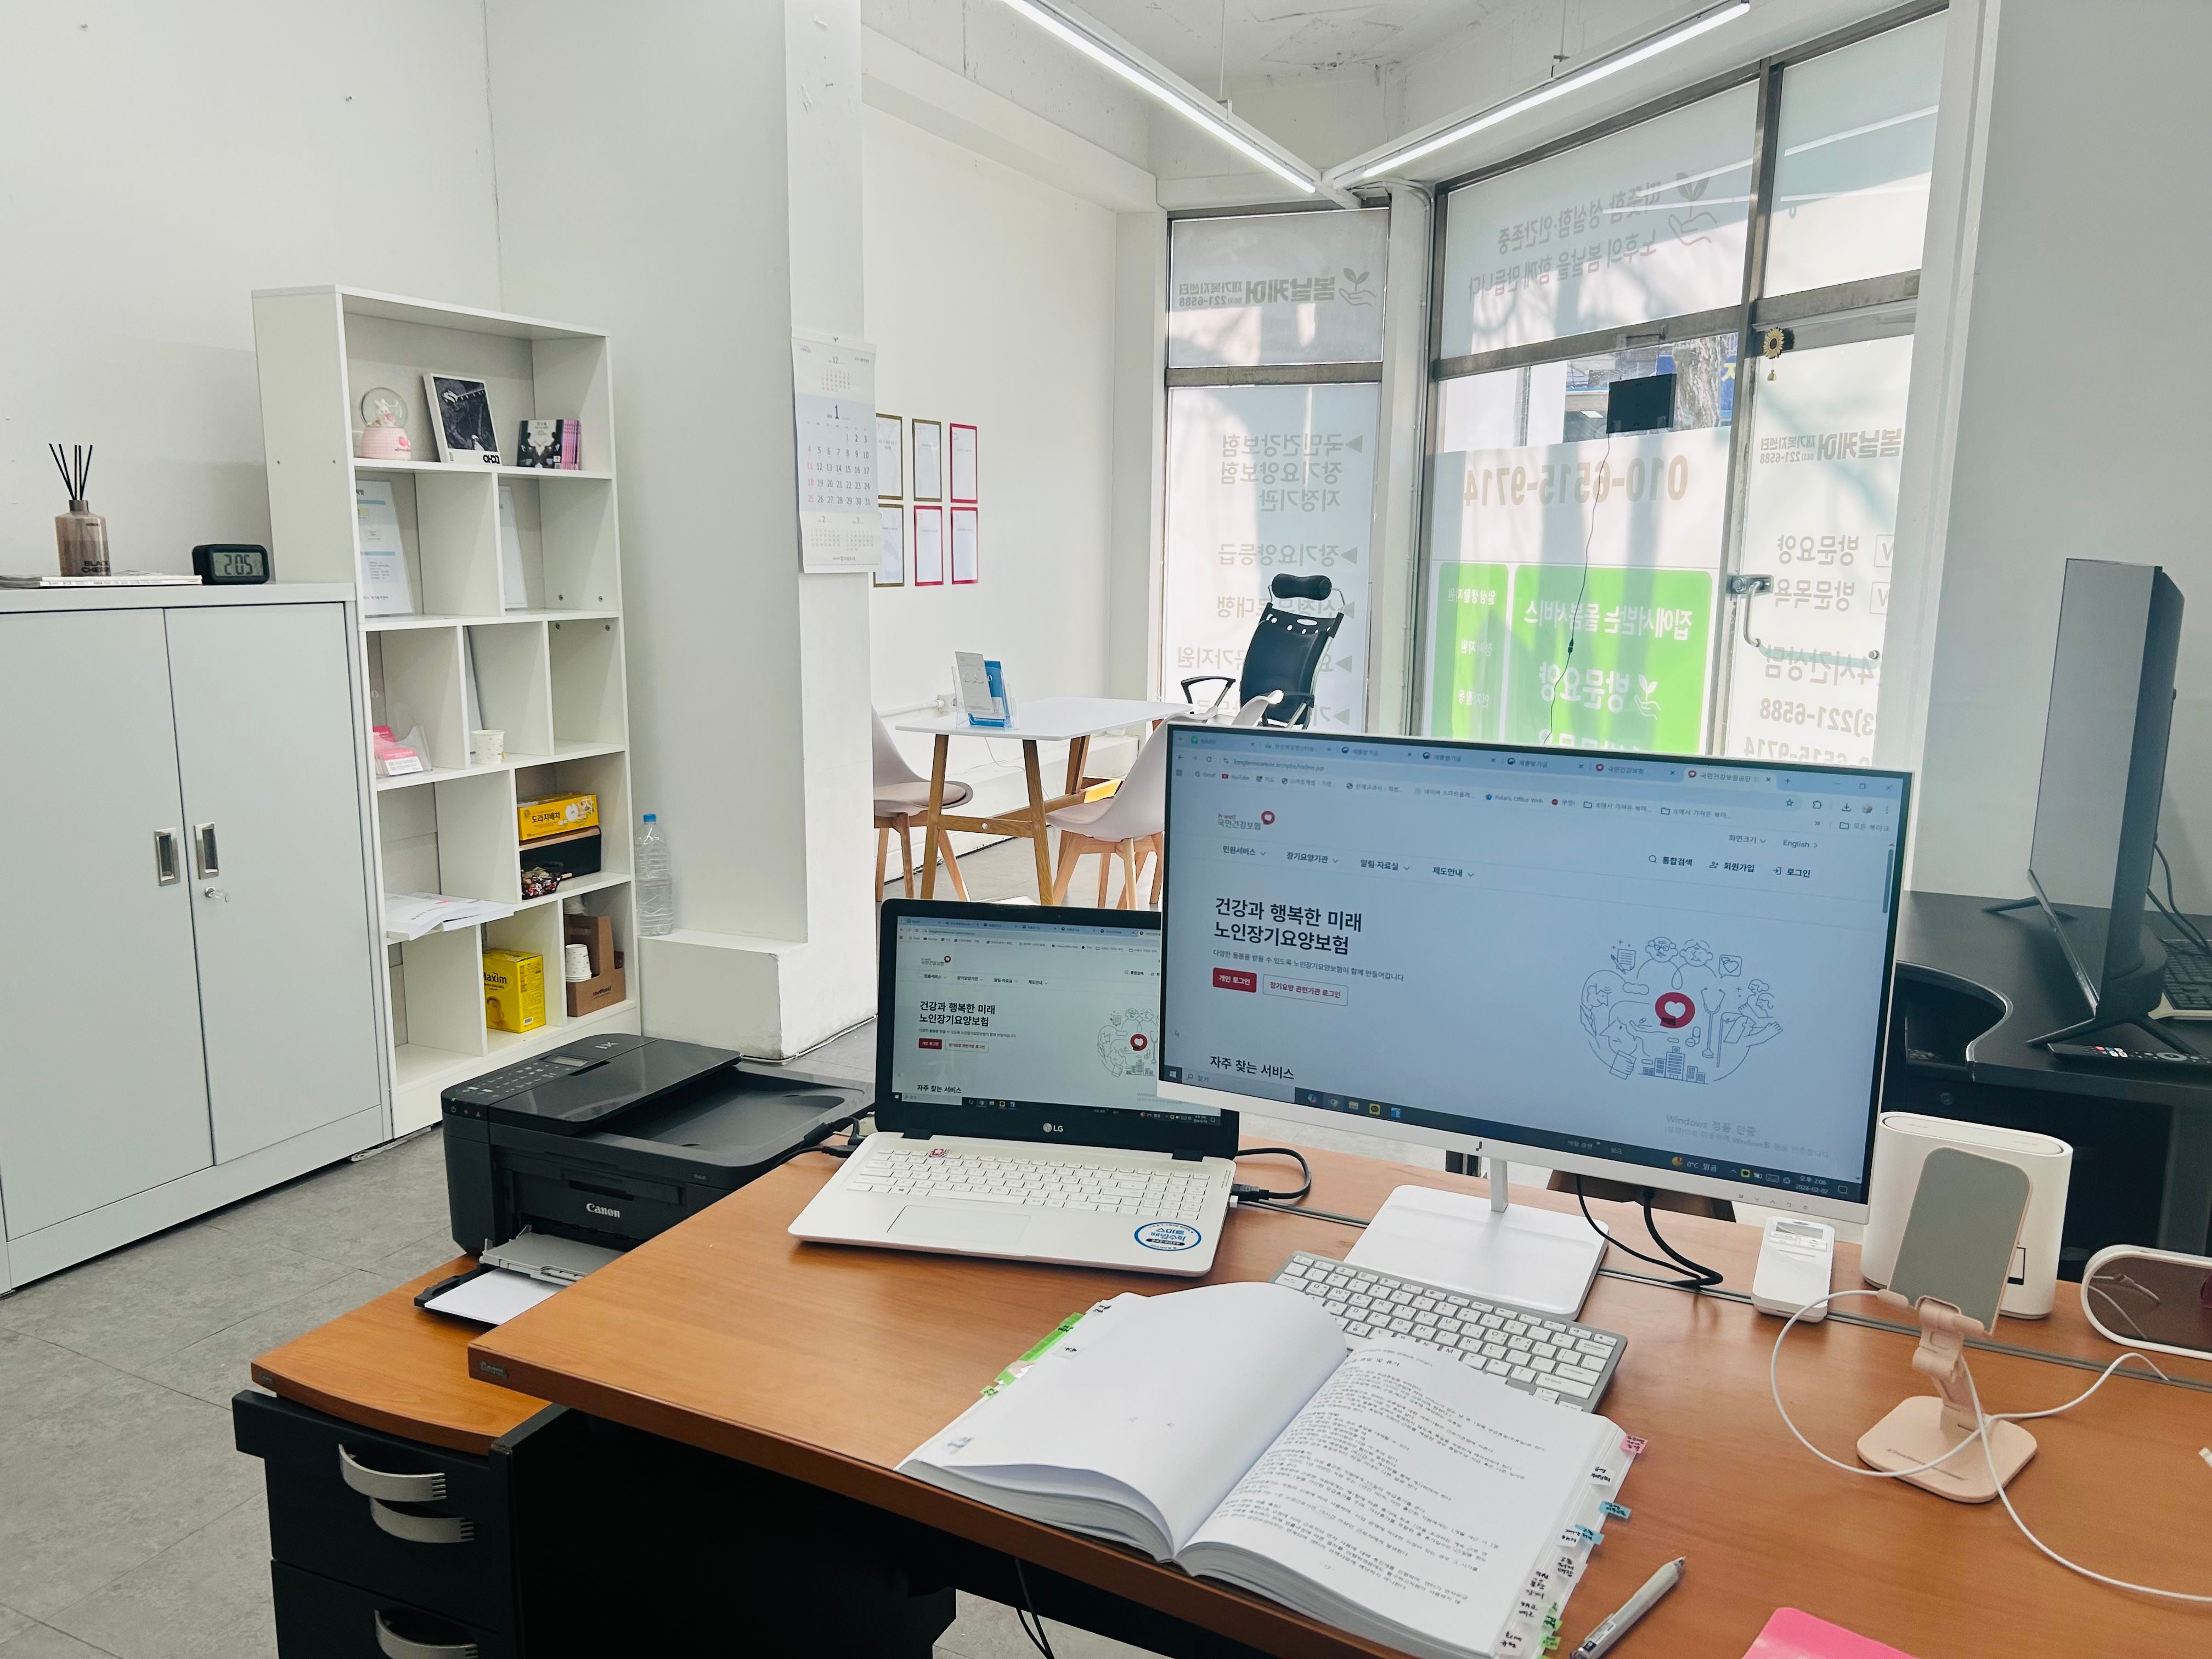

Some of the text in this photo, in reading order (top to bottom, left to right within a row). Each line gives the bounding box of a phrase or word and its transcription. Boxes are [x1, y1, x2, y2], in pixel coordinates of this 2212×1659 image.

[834, 404, 840, 419] 1
[1217, 820, 1261, 831] 국민건강보험
[1729, 834, 1757, 844] 화면크기
[1783, 839, 1810, 849] English
[1222, 845, 1256, 857] 민원서비스
[1286, 851, 1329, 864] 장기요양기관
[1662, 856, 1693, 867] 통합검색
[1724, 862, 1754, 873] 회원가입
[1432, 866, 1463, 878] 제도안내
[1786, 868, 1811, 878] 로그인
[1215, 898, 1363, 933] 건강과 행복한 미래
[1214, 922, 1350, 956] 노인장기요양보험
[1213, 949, 1231, 958] 다양한
[1266, 956, 1272, 964] 수
[1273, 957, 1293, 967] 있도록
[1293, 960, 1350, 975] 노인장기요양보험이
[1351, 967, 1364, 976] 함께
[1365, 969, 1404, 982] 만들어갑니다
[1219, 973, 1251, 986] 개인 로그인
[1269, 981, 1341, 998] 장기요양 관련기관 로그인
[919, 1001, 996, 1015] 건강과 행복한 미래
[919, 1013, 990, 1028] 노인장기요양보험
[1210, 1055, 1295, 1080] 자주 찾는 서비스
[917, 1084, 929, 1092] 자주
[944, 1086, 962, 1094] 서비스
[1666, 1114, 1756, 1137] Windows 정품 인증
[586, 1203, 620, 1218] Canon
